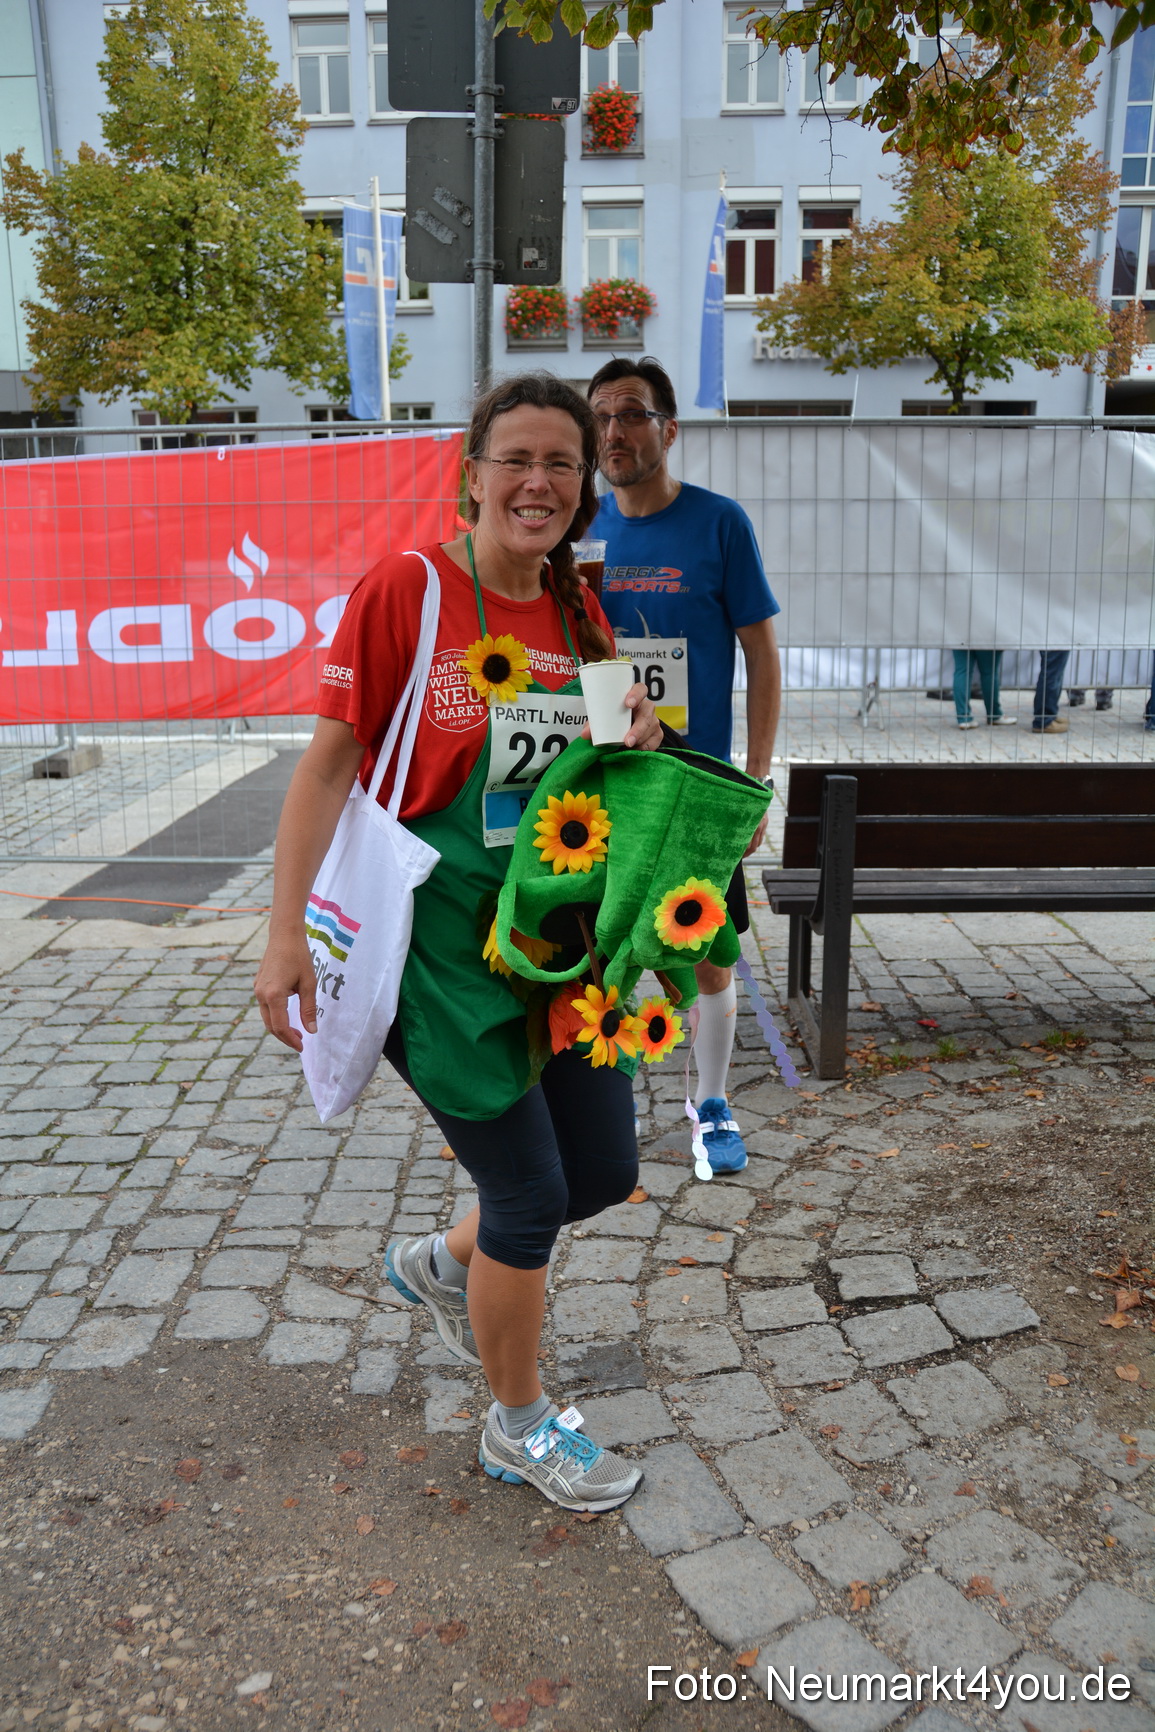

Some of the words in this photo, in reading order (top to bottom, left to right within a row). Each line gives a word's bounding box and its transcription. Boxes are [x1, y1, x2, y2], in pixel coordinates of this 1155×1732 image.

[433, 686, 481, 708] NEU
[435, 705, 484, 721] MARKT
[495, 706, 549, 724] PARTL
